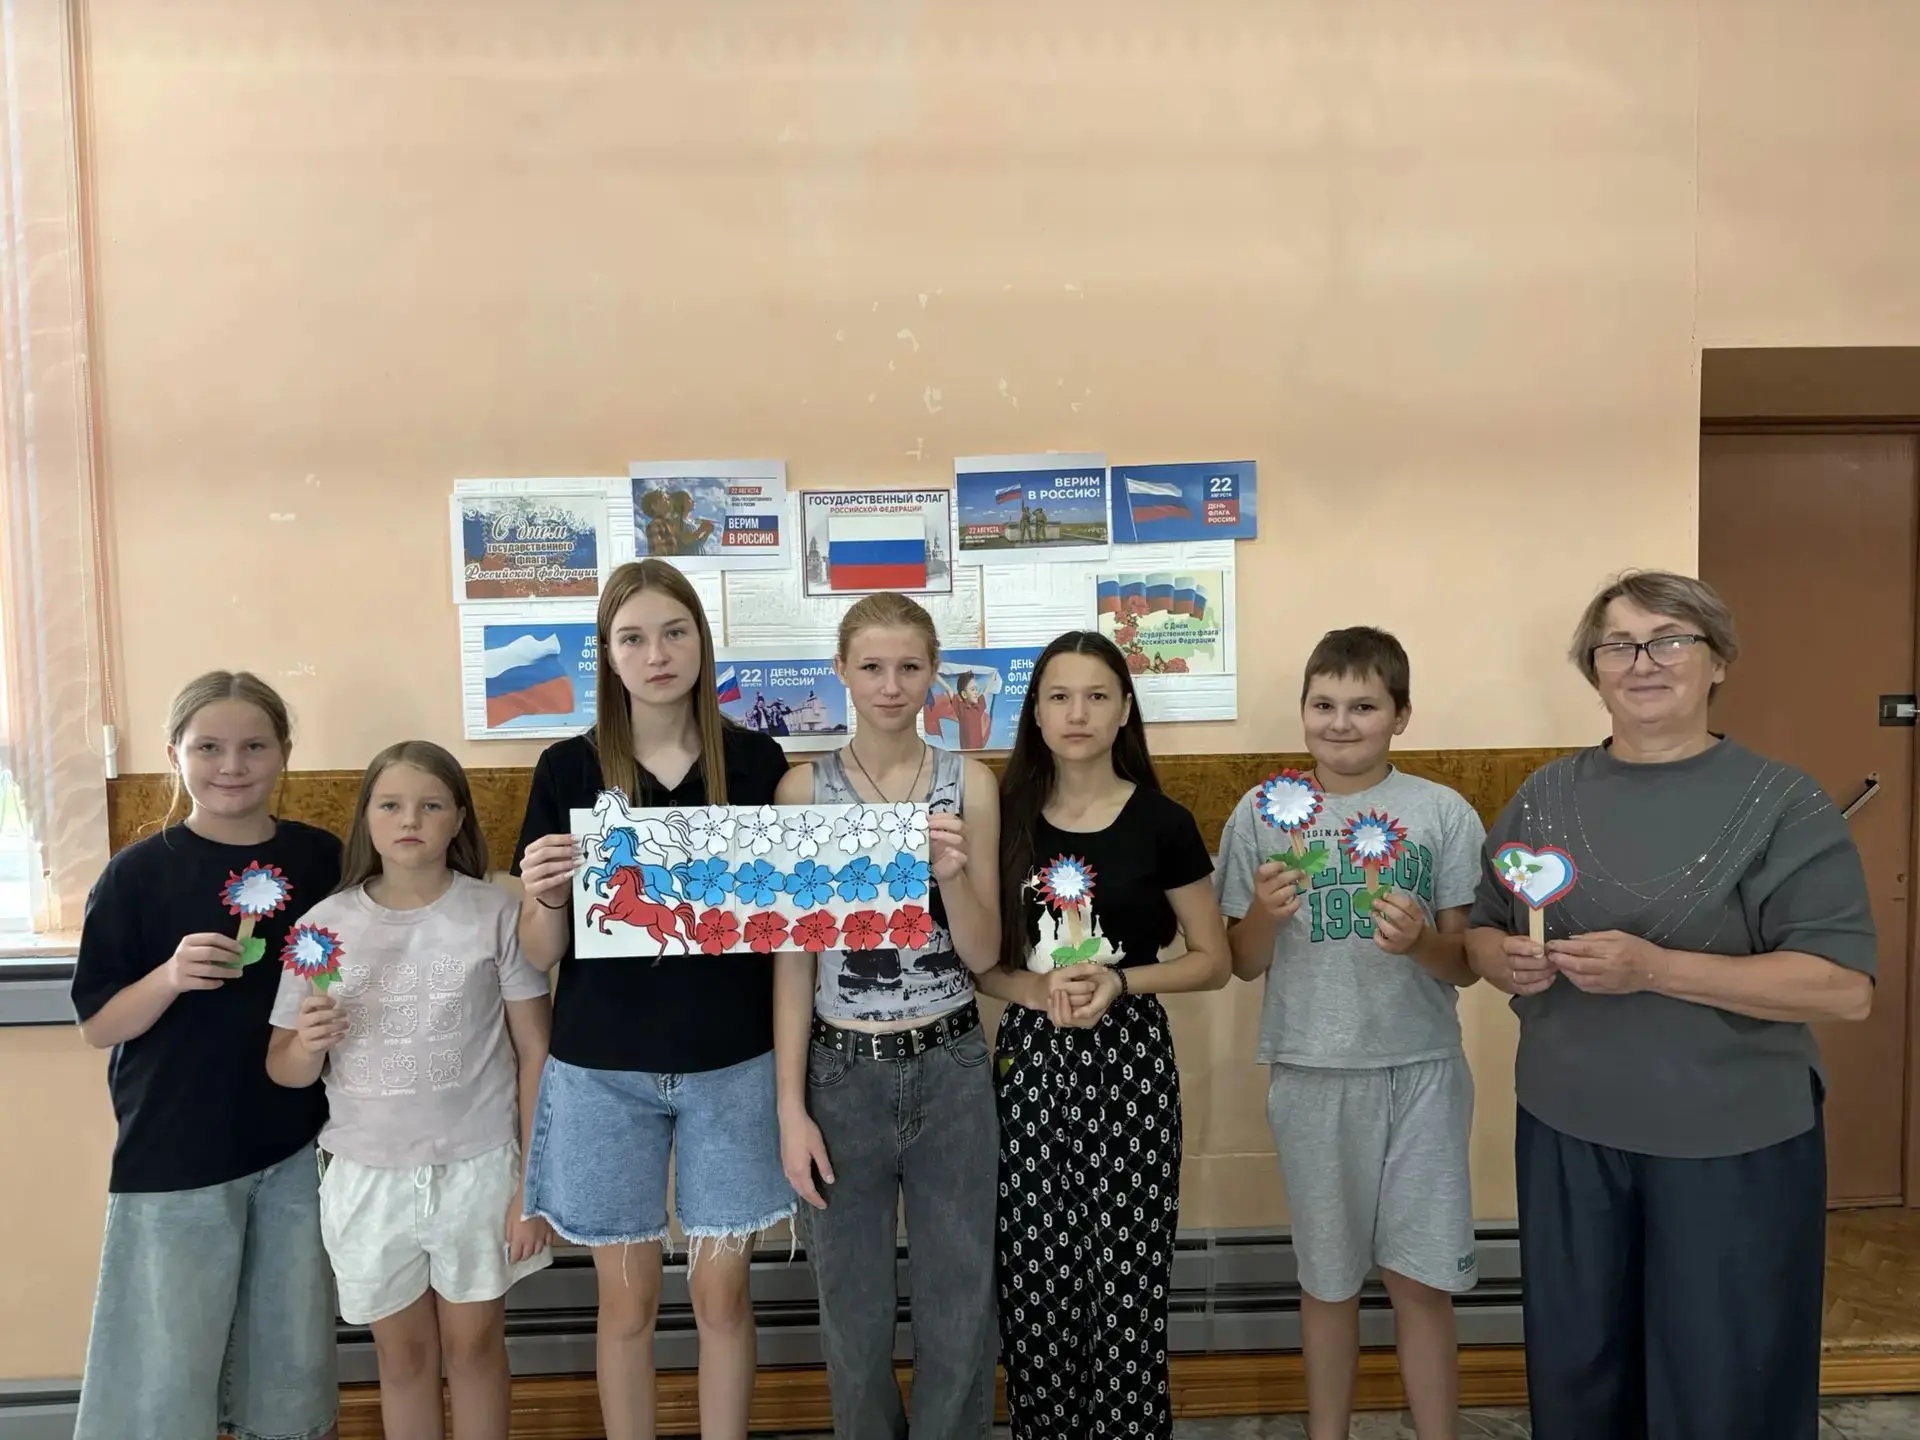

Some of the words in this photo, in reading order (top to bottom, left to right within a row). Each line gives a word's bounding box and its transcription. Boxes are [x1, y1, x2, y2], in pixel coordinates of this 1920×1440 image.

[1055, 477, 1100, 488] ВЕРИМ
[1210, 477, 1233, 492] 22
[809, 493, 914, 505] ГОСУДАРСТВЕННЫЙ
[915, 494, 944, 503] ФЛАГ
[1028, 490, 1037, 500] В
[1040, 489, 1101, 499] РОССИЮ!
[492, 513, 512, 540] С
[728, 518, 759, 529] ВЕРИМ
[729, 533, 736, 544] В
[737, 533, 774, 544] РОССИЮ
[488, 543, 573, 553] государственного
[516, 555, 547, 565] флага
[465, 564, 534, 580] Российской
[538, 565, 599, 580] федерации
[1136, 630, 1196, 638] Государственного
[1197, 629, 1219, 637] флага
[584, 635, 598, 647] ДЕ
[1178, 637, 1216, 645] Федерации
[578, 661, 598, 672] РОС
[1010, 659, 1035, 670] ДЕНЬ
[740, 669, 762, 682] 22
[770, 668, 799, 678] ДЕНЬ
[800, 667, 836, 676] ФЛАГА
[1007, 672, 1032, 682] ФЛАГ
[771, 677, 816, 687] РОССИИ
[1004, 685, 1028, 695] РОСС
[1308, 887, 1374, 943] 199
